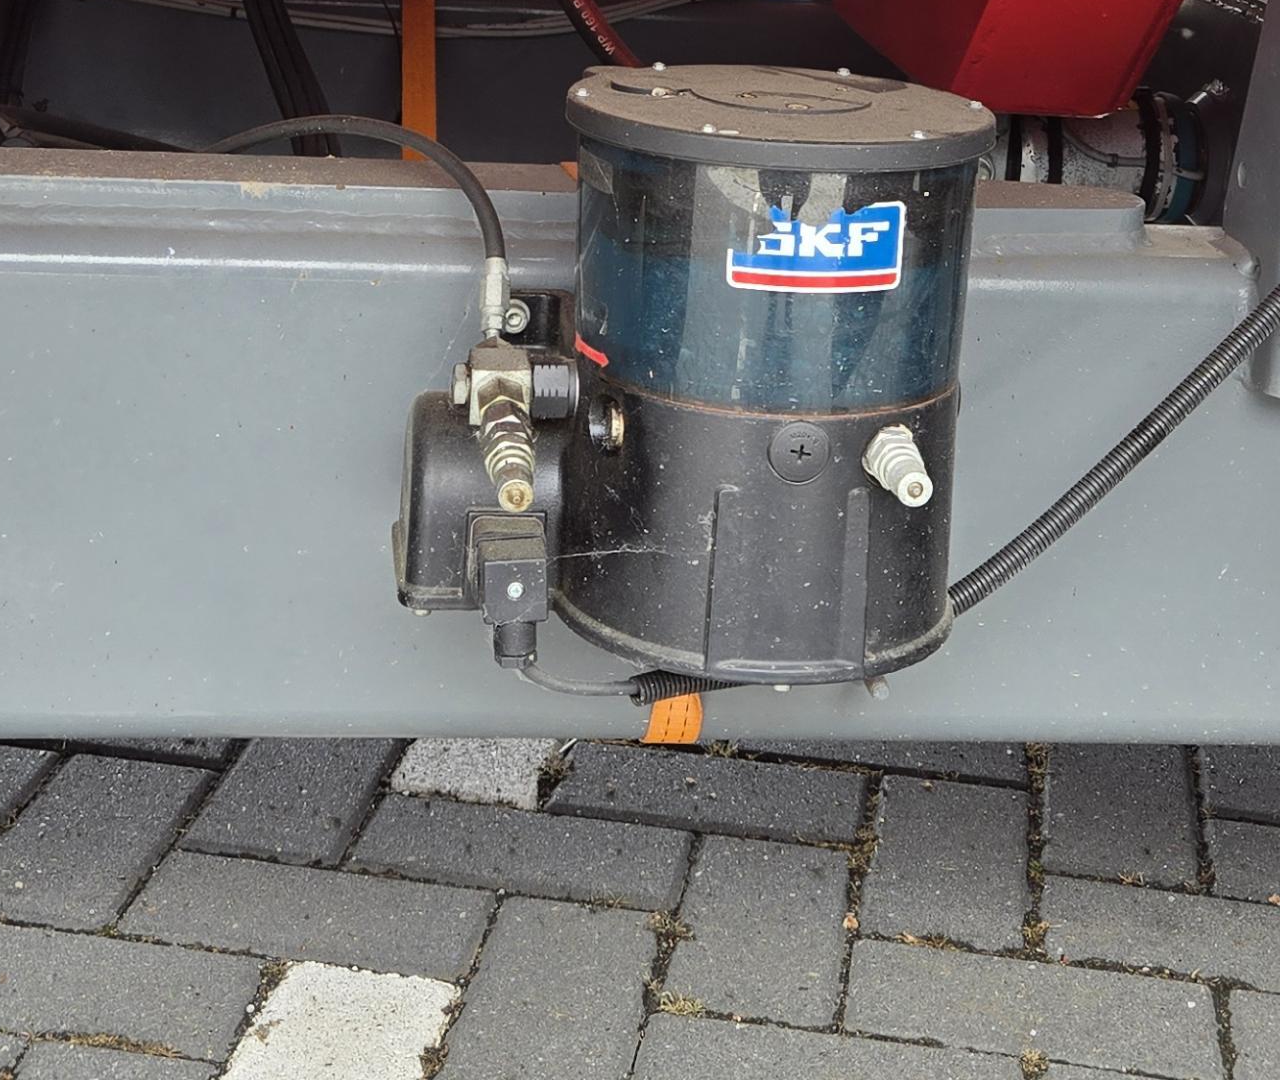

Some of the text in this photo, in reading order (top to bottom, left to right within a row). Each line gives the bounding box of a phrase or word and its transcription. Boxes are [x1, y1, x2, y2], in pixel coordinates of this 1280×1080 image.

[580, 10, 598, 32] 160
[597, 34, 616, 56] WP
[757, 220, 890, 258] SKF
